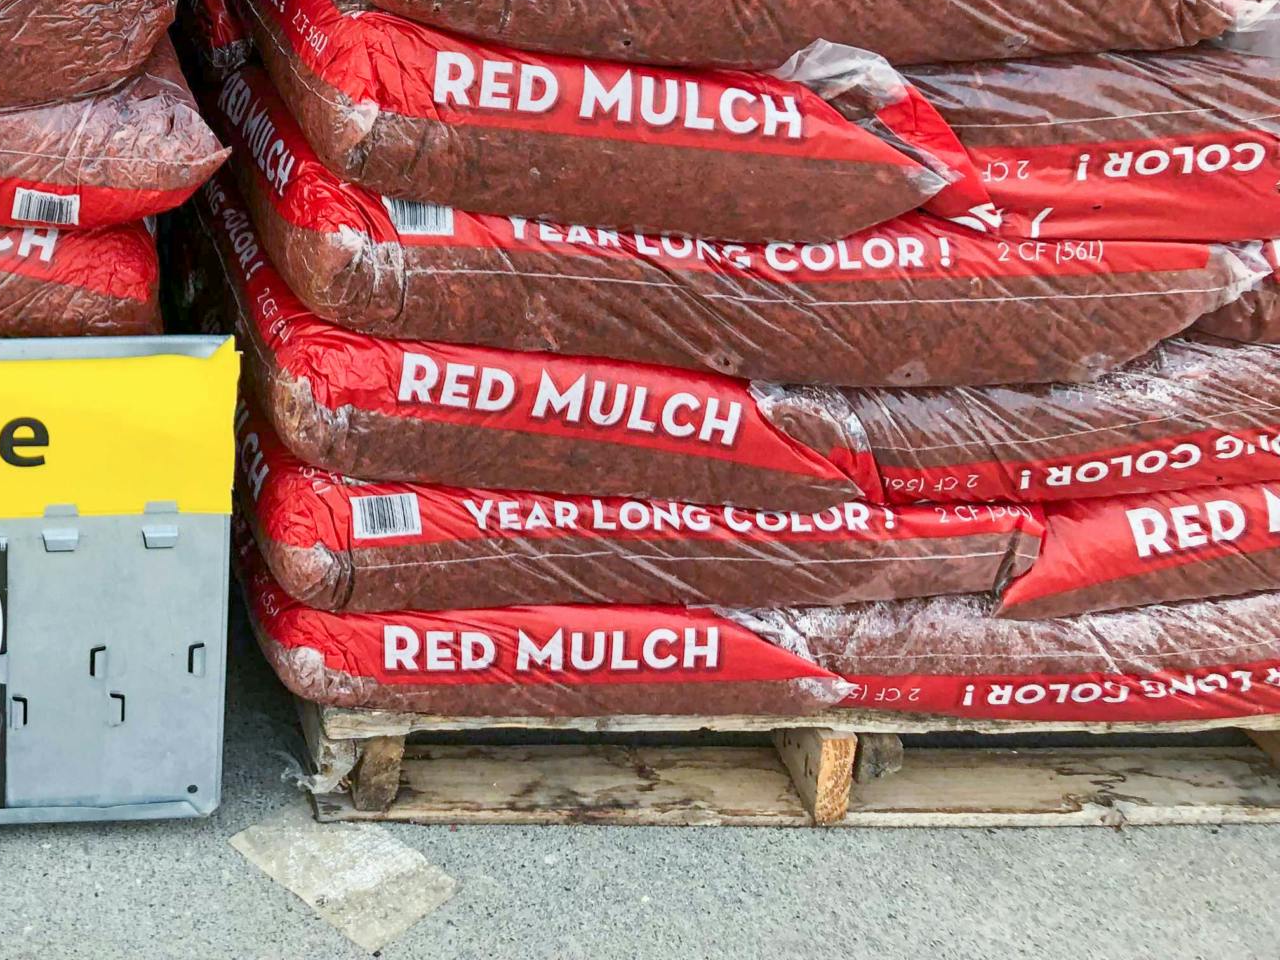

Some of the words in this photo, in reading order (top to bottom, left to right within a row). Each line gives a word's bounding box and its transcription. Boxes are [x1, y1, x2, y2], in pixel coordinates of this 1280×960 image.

[433, 50, 560, 114] RED
[579, 64, 802, 139] MULCH
[981, 162, 1009, 183] CF
[1017, 160, 1030, 180] 2
[508, 215, 621, 248] YEAR
[633, 231, 752, 269] LONG
[997, 243, 1010, 262] 2
[1017, 242, 1047, 261] CF
[398, 352, 516, 412] RED
[530, 368, 742, 446] MULCH
[934, 476, 960, 492] CF
[966, 474, 980, 489] 2
[463, 498, 579, 530] YEAR
[593, 499, 711, 531] LONG
[934, 507, 950, 523] 2
[1126, 501, 1247, 558] RED
[383, 625, 496, 672] RED
[515, 627, 720, 672] MULCH
[874, 687, 903, 703] CF
[909, 687, 921, 702] 2
[1143, 670, 1254, 700] LONG
